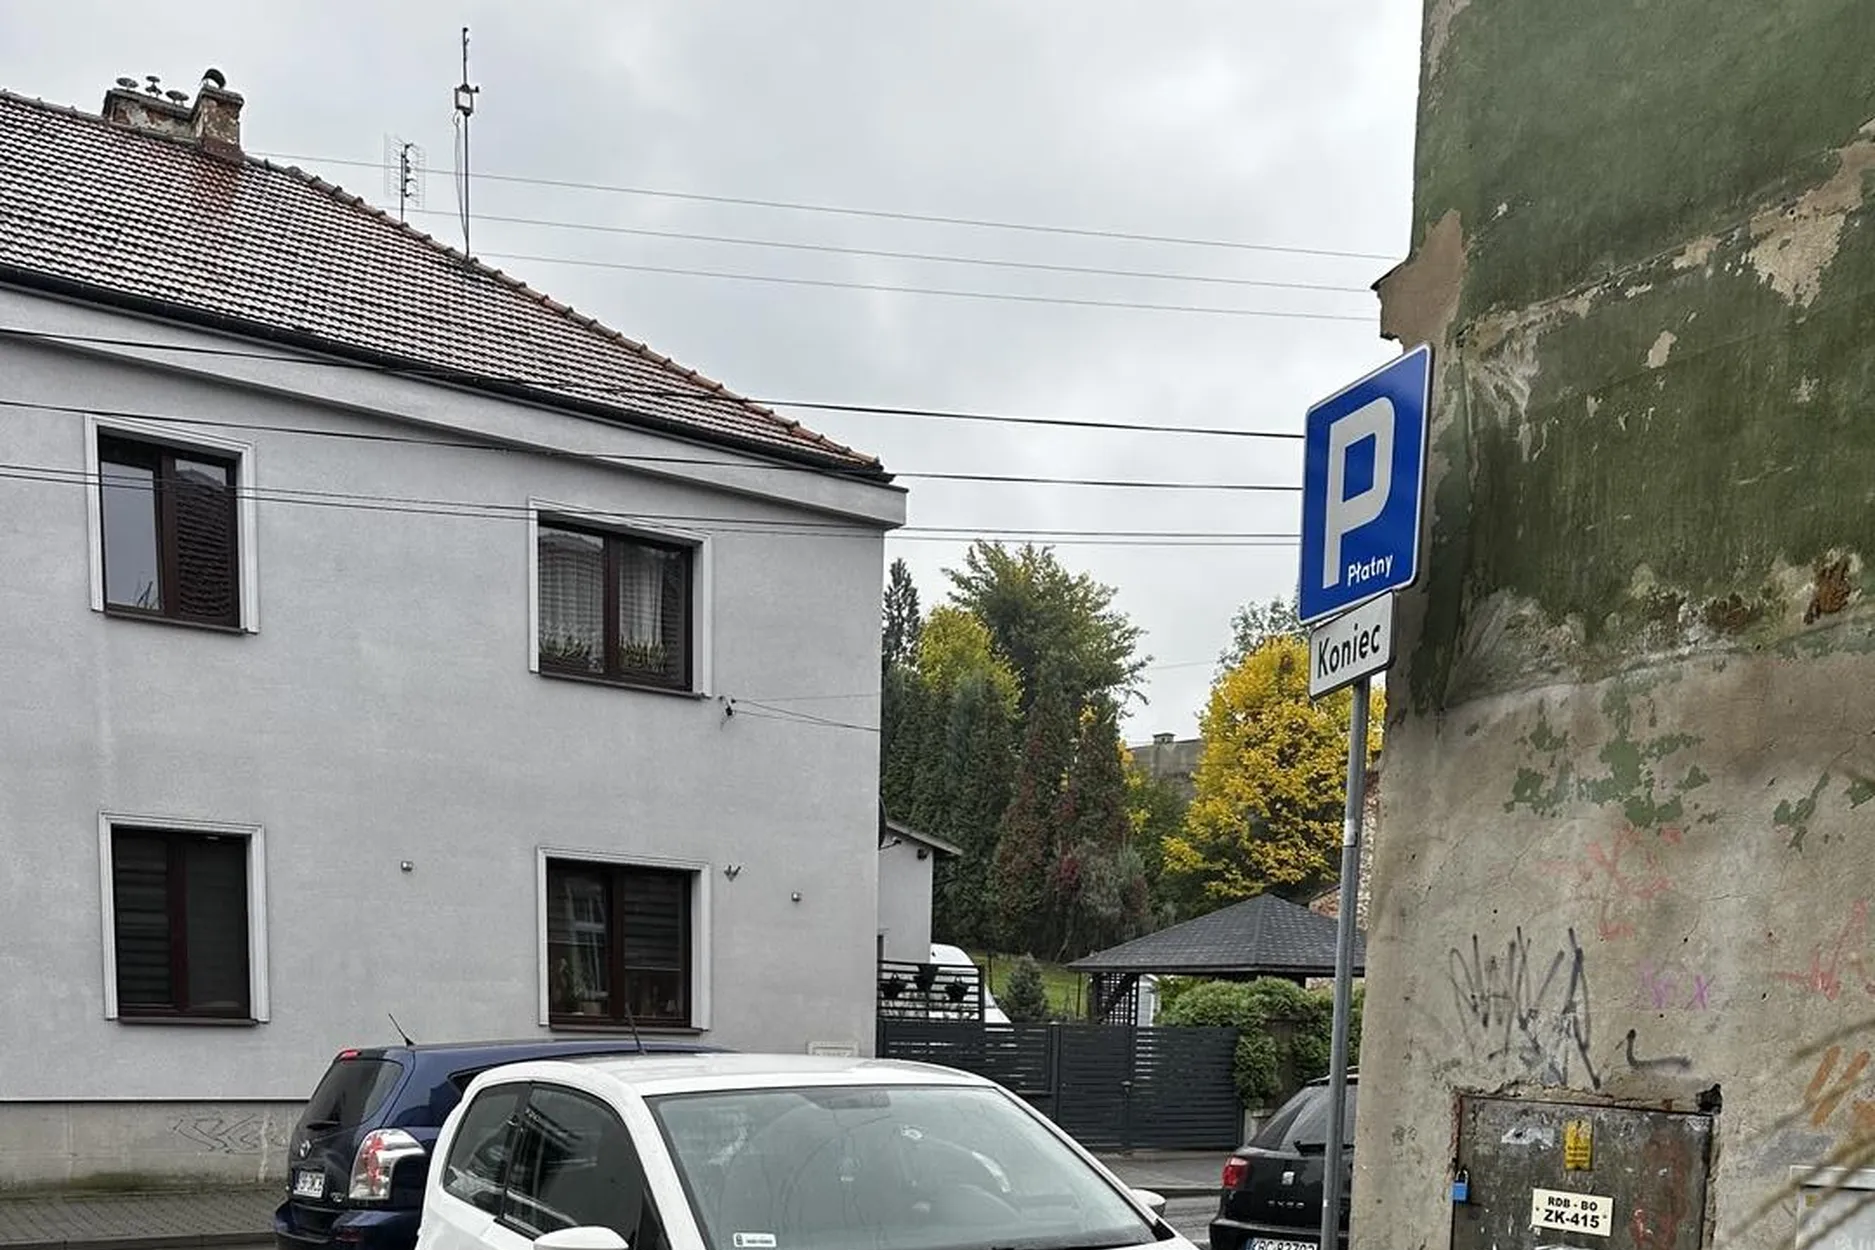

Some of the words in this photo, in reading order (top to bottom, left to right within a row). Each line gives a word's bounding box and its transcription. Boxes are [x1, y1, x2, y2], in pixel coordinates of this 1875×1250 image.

[1323, 397, 1395, 589] P
[1347, 555, 1393, 587] Płatny
[1317, 623, 1380, 679] Koniec
[1544, 1209, 1600, 1228] ZK-415
